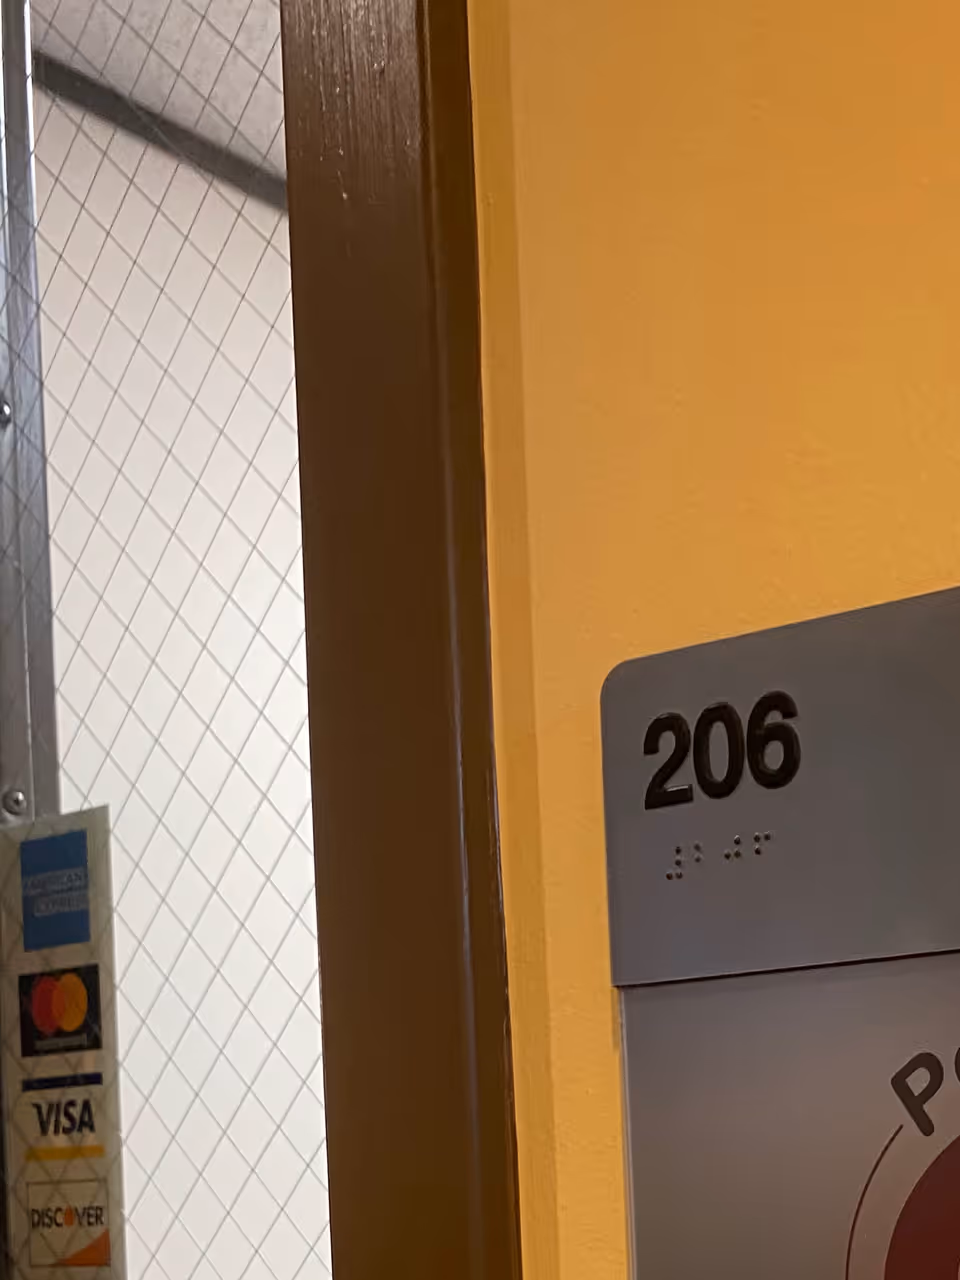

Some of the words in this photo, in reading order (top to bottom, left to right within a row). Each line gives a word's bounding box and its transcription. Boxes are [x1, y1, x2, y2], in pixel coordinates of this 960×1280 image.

[643, 690, 802, 811] 206
[31, 1099, 96, 1136] VISA
[31, 1206, 104, 1228] DISCOVER
